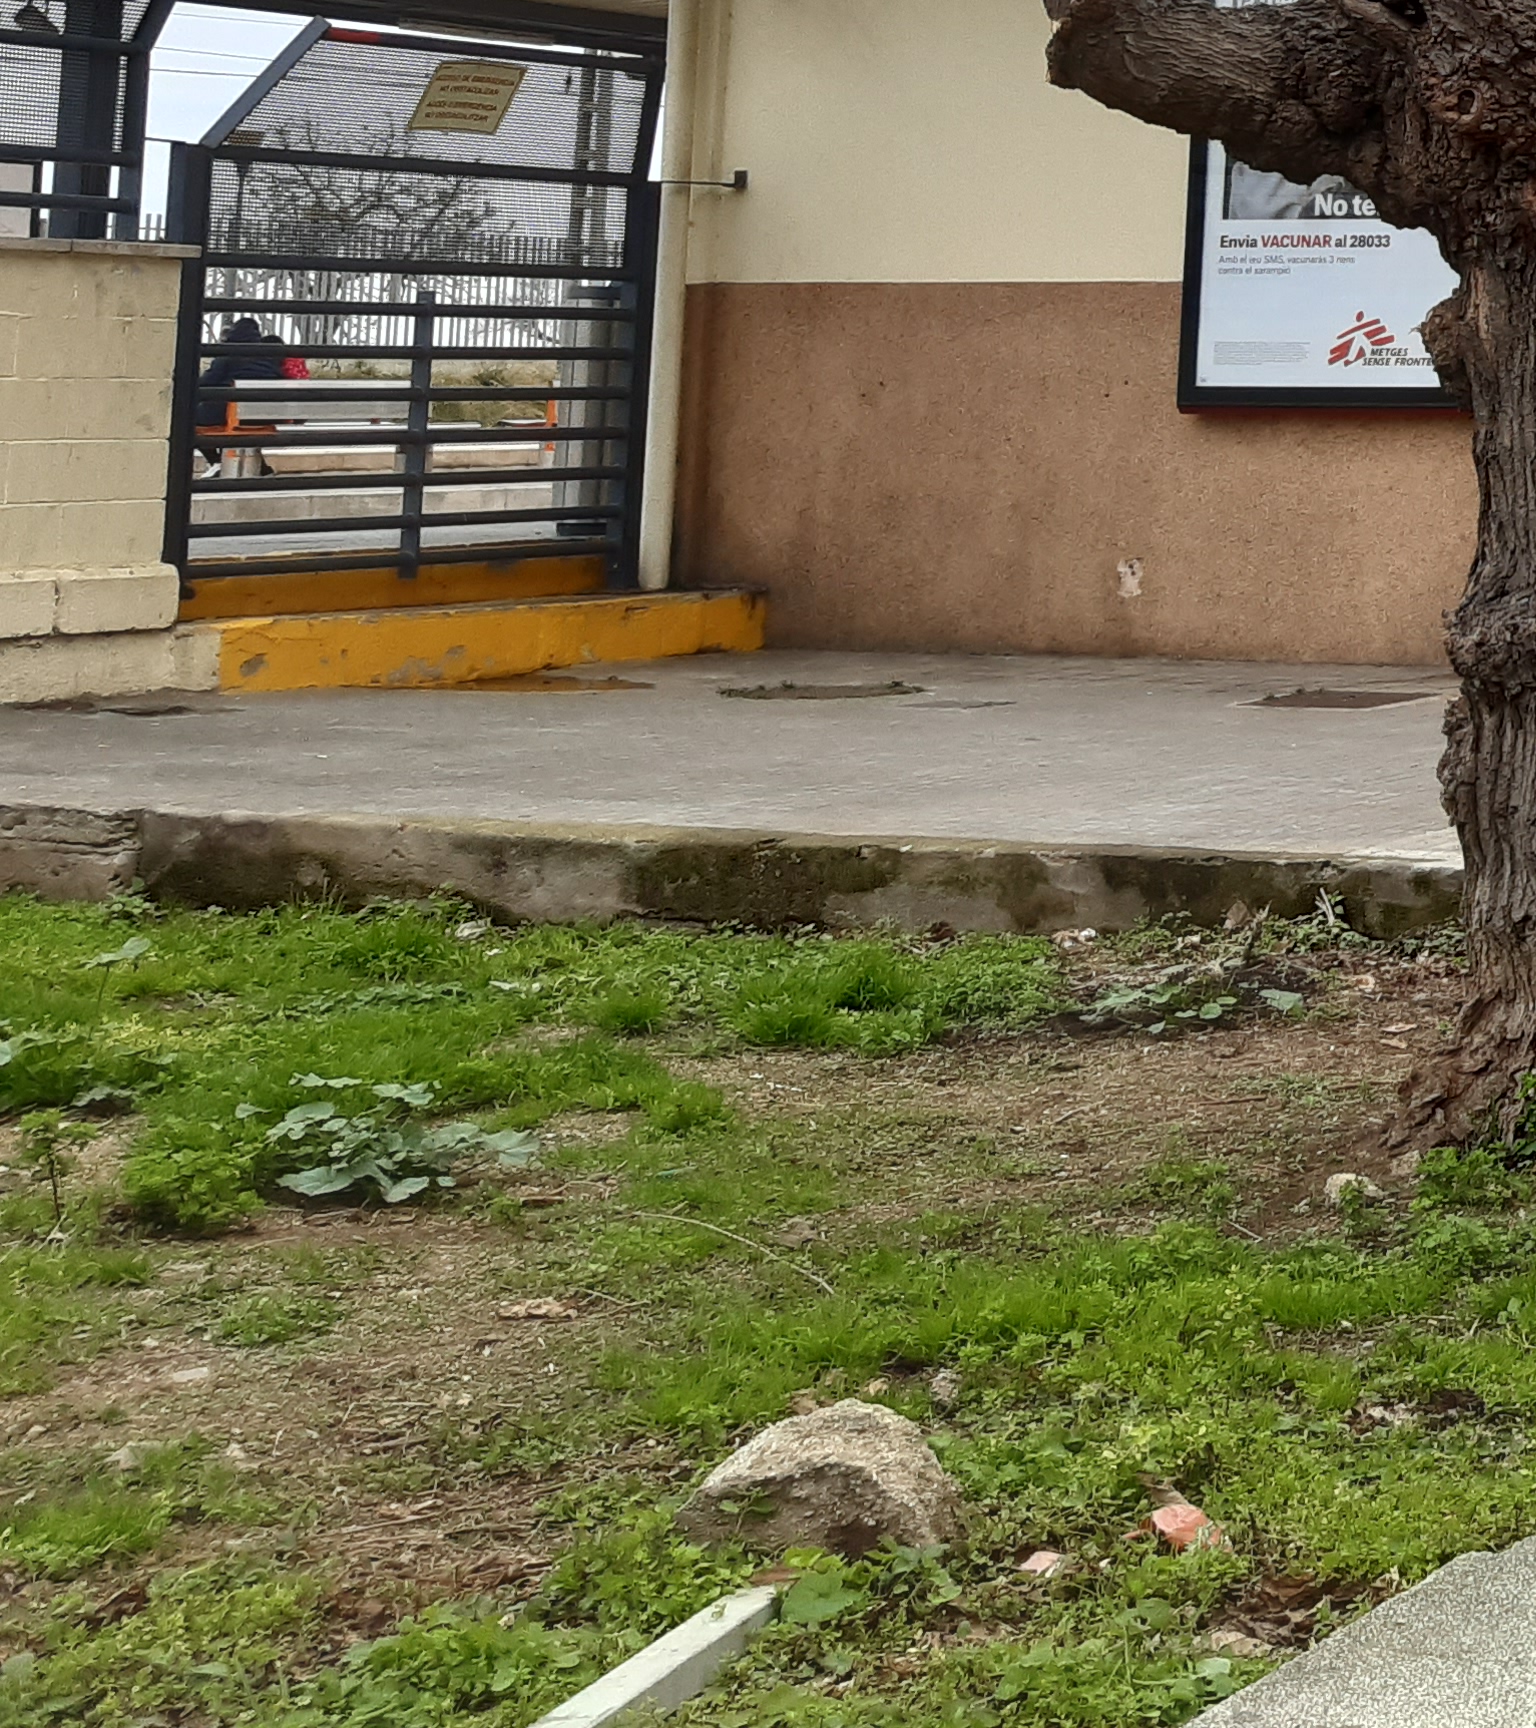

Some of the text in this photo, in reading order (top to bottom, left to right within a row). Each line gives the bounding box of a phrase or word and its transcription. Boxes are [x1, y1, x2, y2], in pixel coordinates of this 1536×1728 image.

[1313, 193, 1380, 217] No te
[1219, 234, 1391, 248] Envia VACUNAR al 28033
[1370, 347, 1409, 357] METGES
[1361, 357, 1433, 367] SENSE FRONTE
